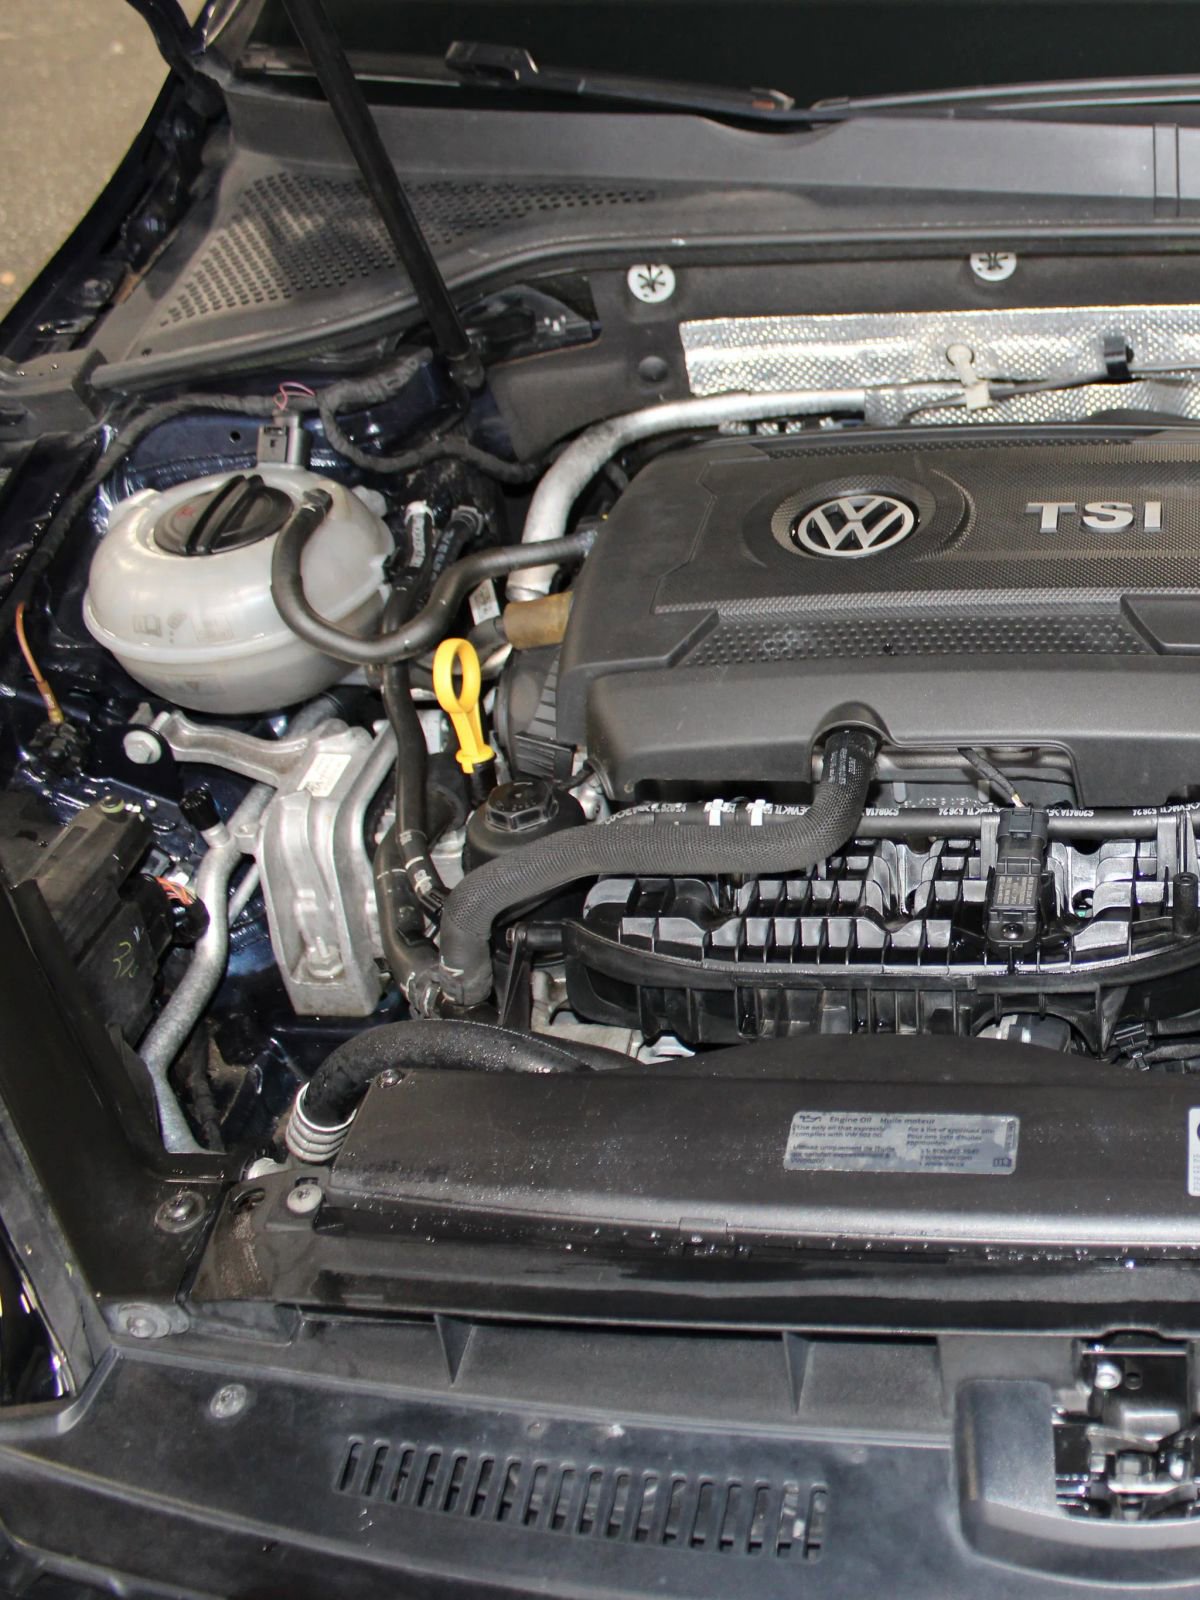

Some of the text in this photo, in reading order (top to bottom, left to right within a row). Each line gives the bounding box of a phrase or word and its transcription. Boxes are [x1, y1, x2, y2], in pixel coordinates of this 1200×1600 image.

[1027, 501, 1162, 534] TSI
[829, 1115, 858, 1123] Engine
[904, 1117, 936, 1125] moteur
